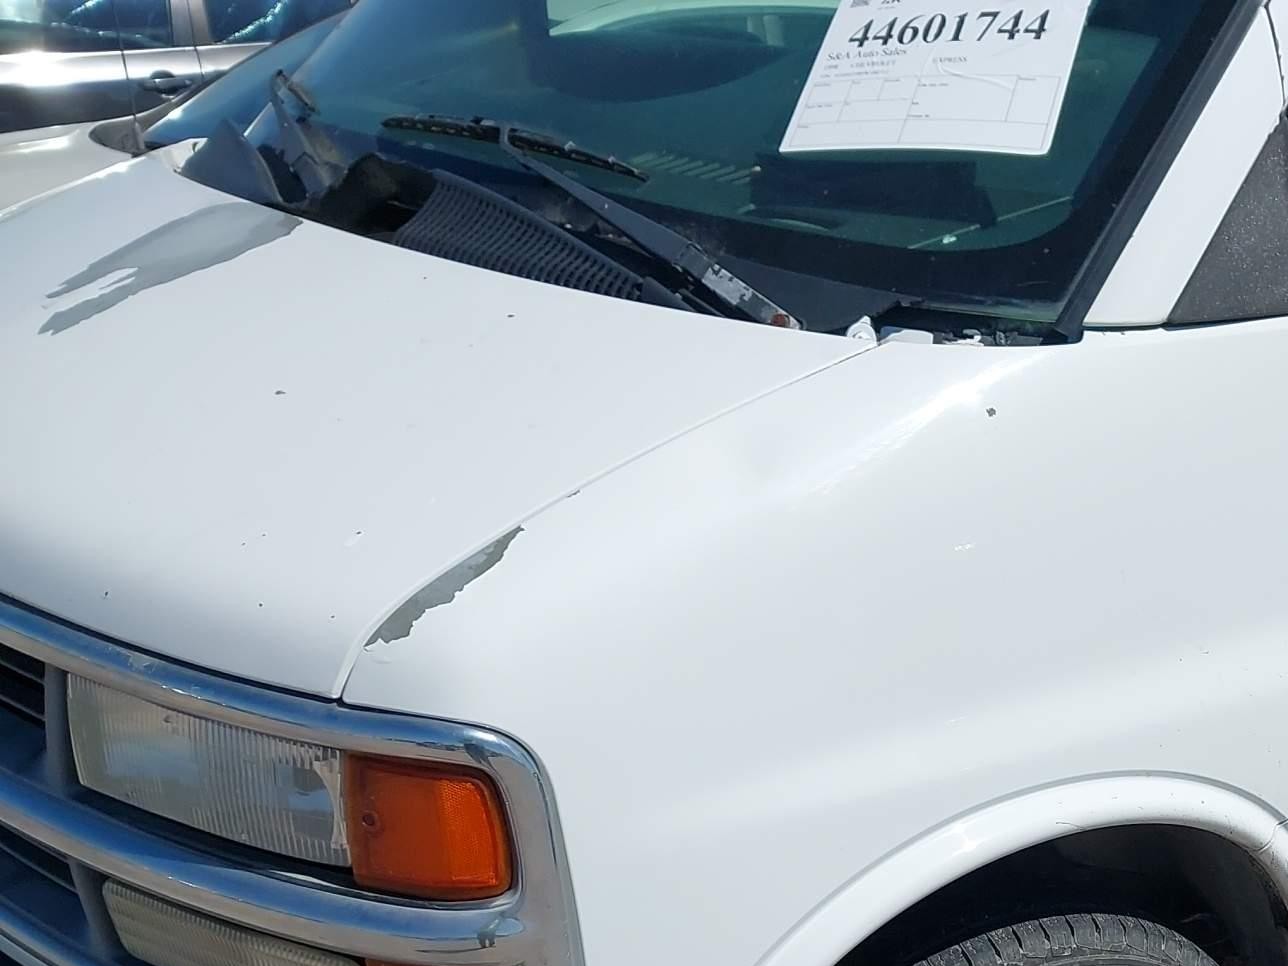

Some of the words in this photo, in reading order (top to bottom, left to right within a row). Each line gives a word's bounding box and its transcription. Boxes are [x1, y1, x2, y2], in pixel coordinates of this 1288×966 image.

[848, 9, 1050, 47] 44601744
[853, 49, 878, 59] Auto
[881, 47, 907, 57] Sales
